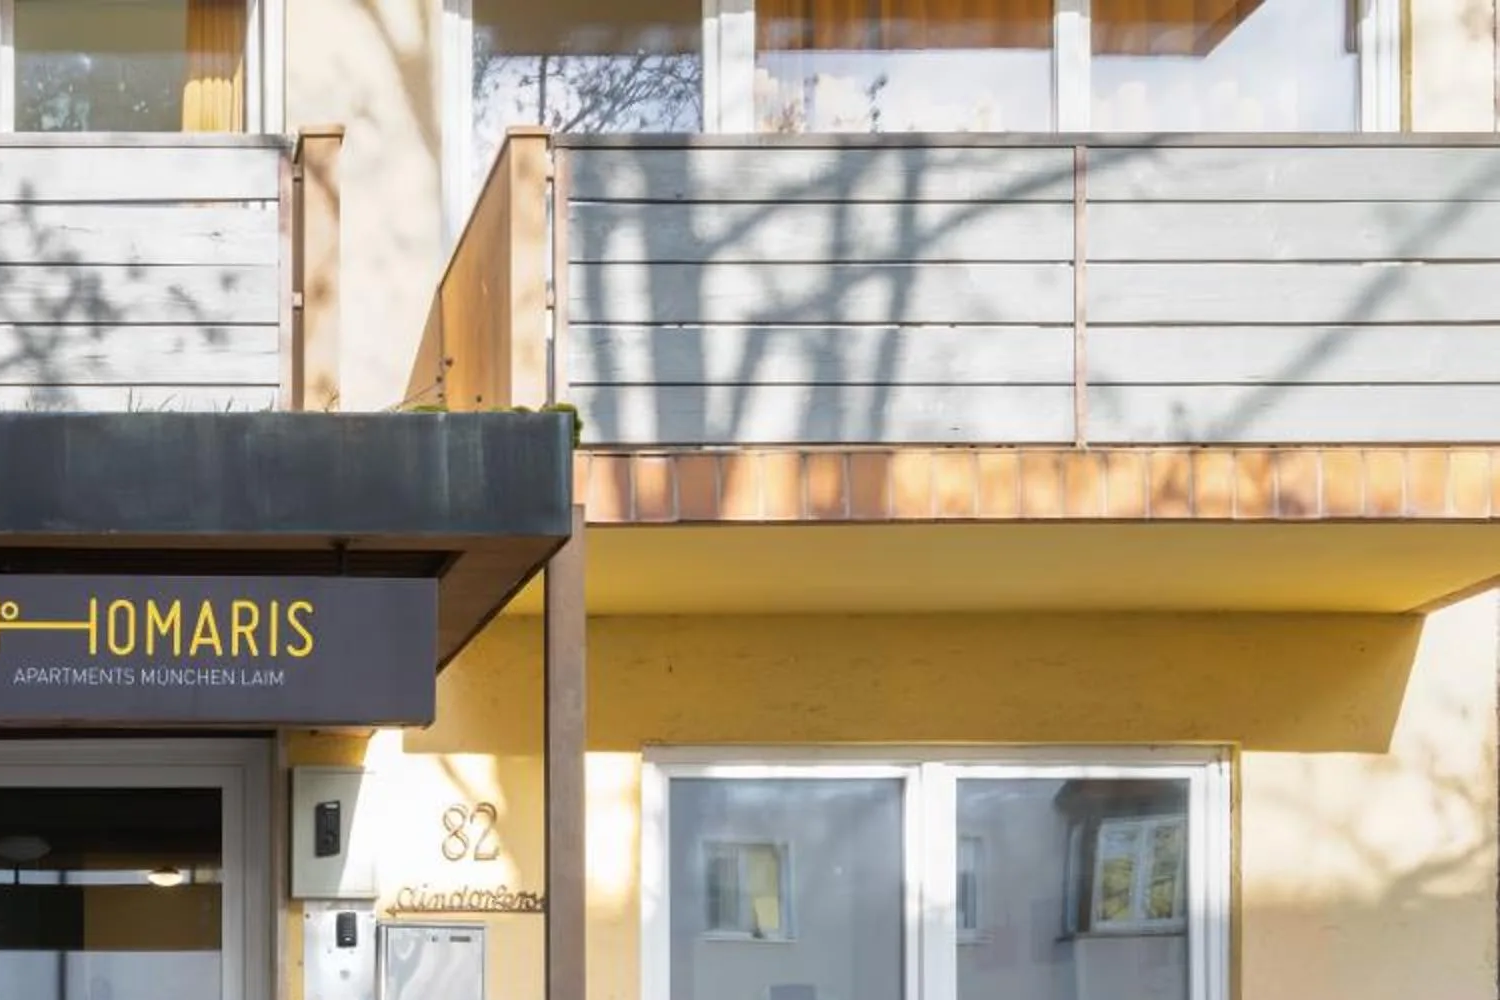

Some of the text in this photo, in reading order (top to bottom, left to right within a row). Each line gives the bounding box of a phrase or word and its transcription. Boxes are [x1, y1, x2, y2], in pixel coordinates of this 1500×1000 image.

[12, 665, 285, 686] APARTMENTS MÜNCHEN LAIM
[441, 802, 500, 861] 82
